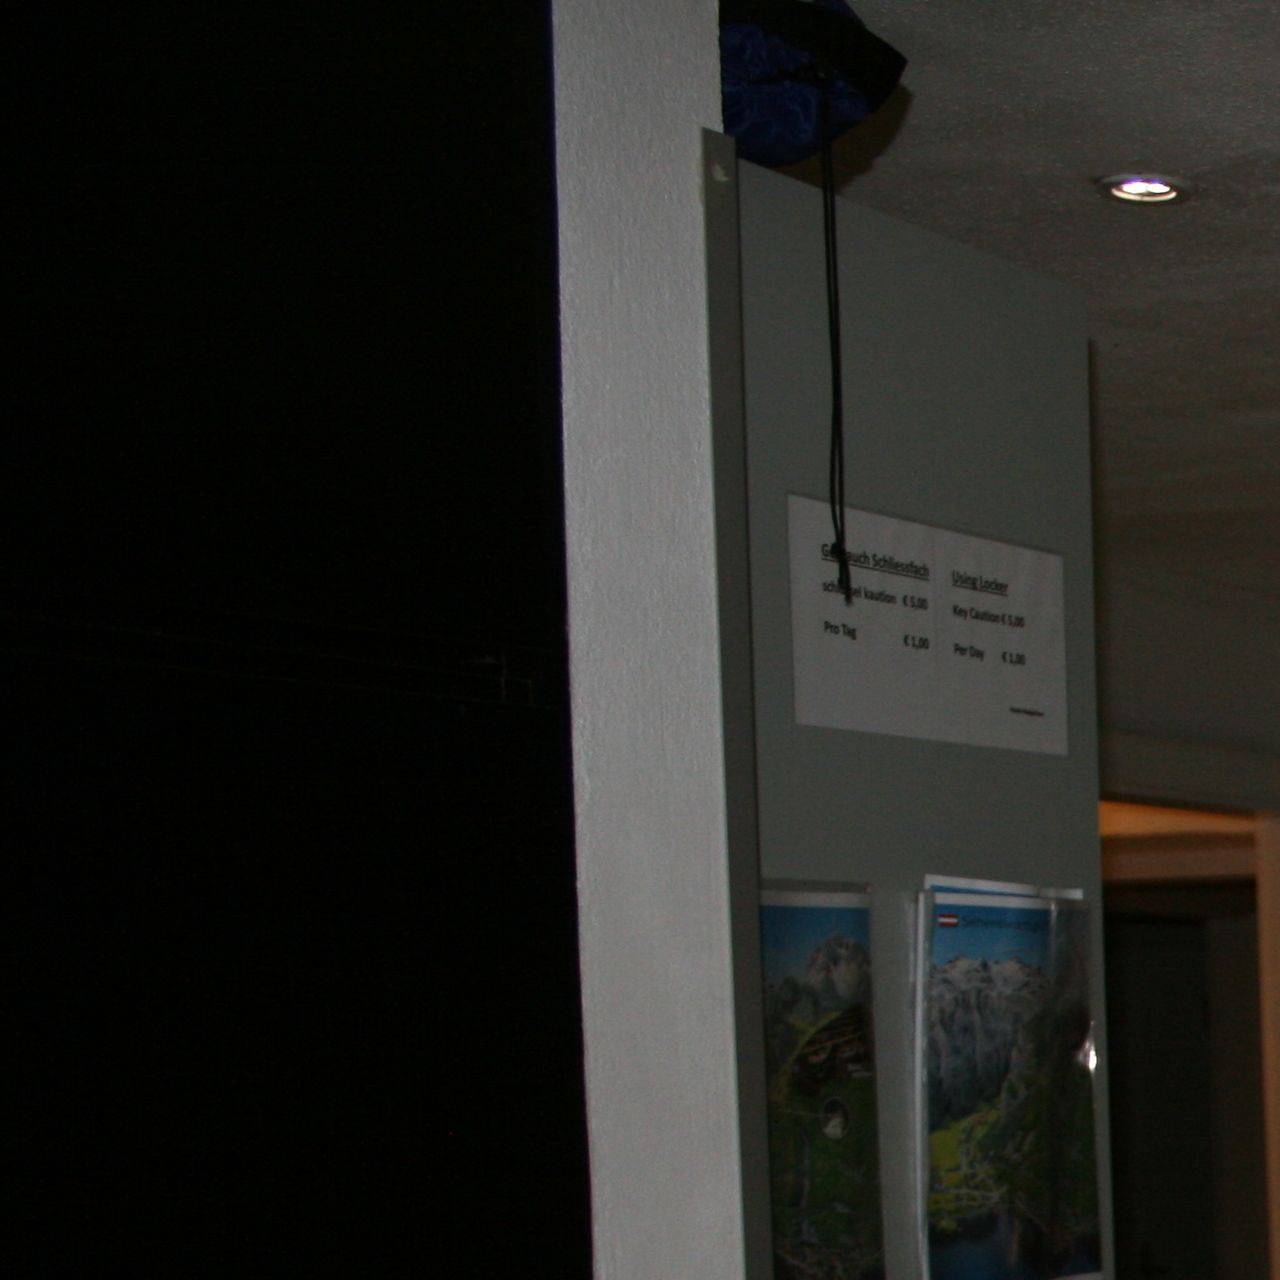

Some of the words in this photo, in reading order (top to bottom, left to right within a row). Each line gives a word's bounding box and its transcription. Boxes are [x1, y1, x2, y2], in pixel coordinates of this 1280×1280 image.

[821, 543, 870, 567] Gauch
[952, 570, 978, 590] Using
[979, 576, 1008, 593] Locker
[910, 596, 929, 611] 5,00
[953, 604, 968, 621] Key
[824, 620, 840, 635] Pro
[841, 623, 857, 641] Tag
[954, 643, 968, 656] Per
[969, 645, 985, 662] Day
